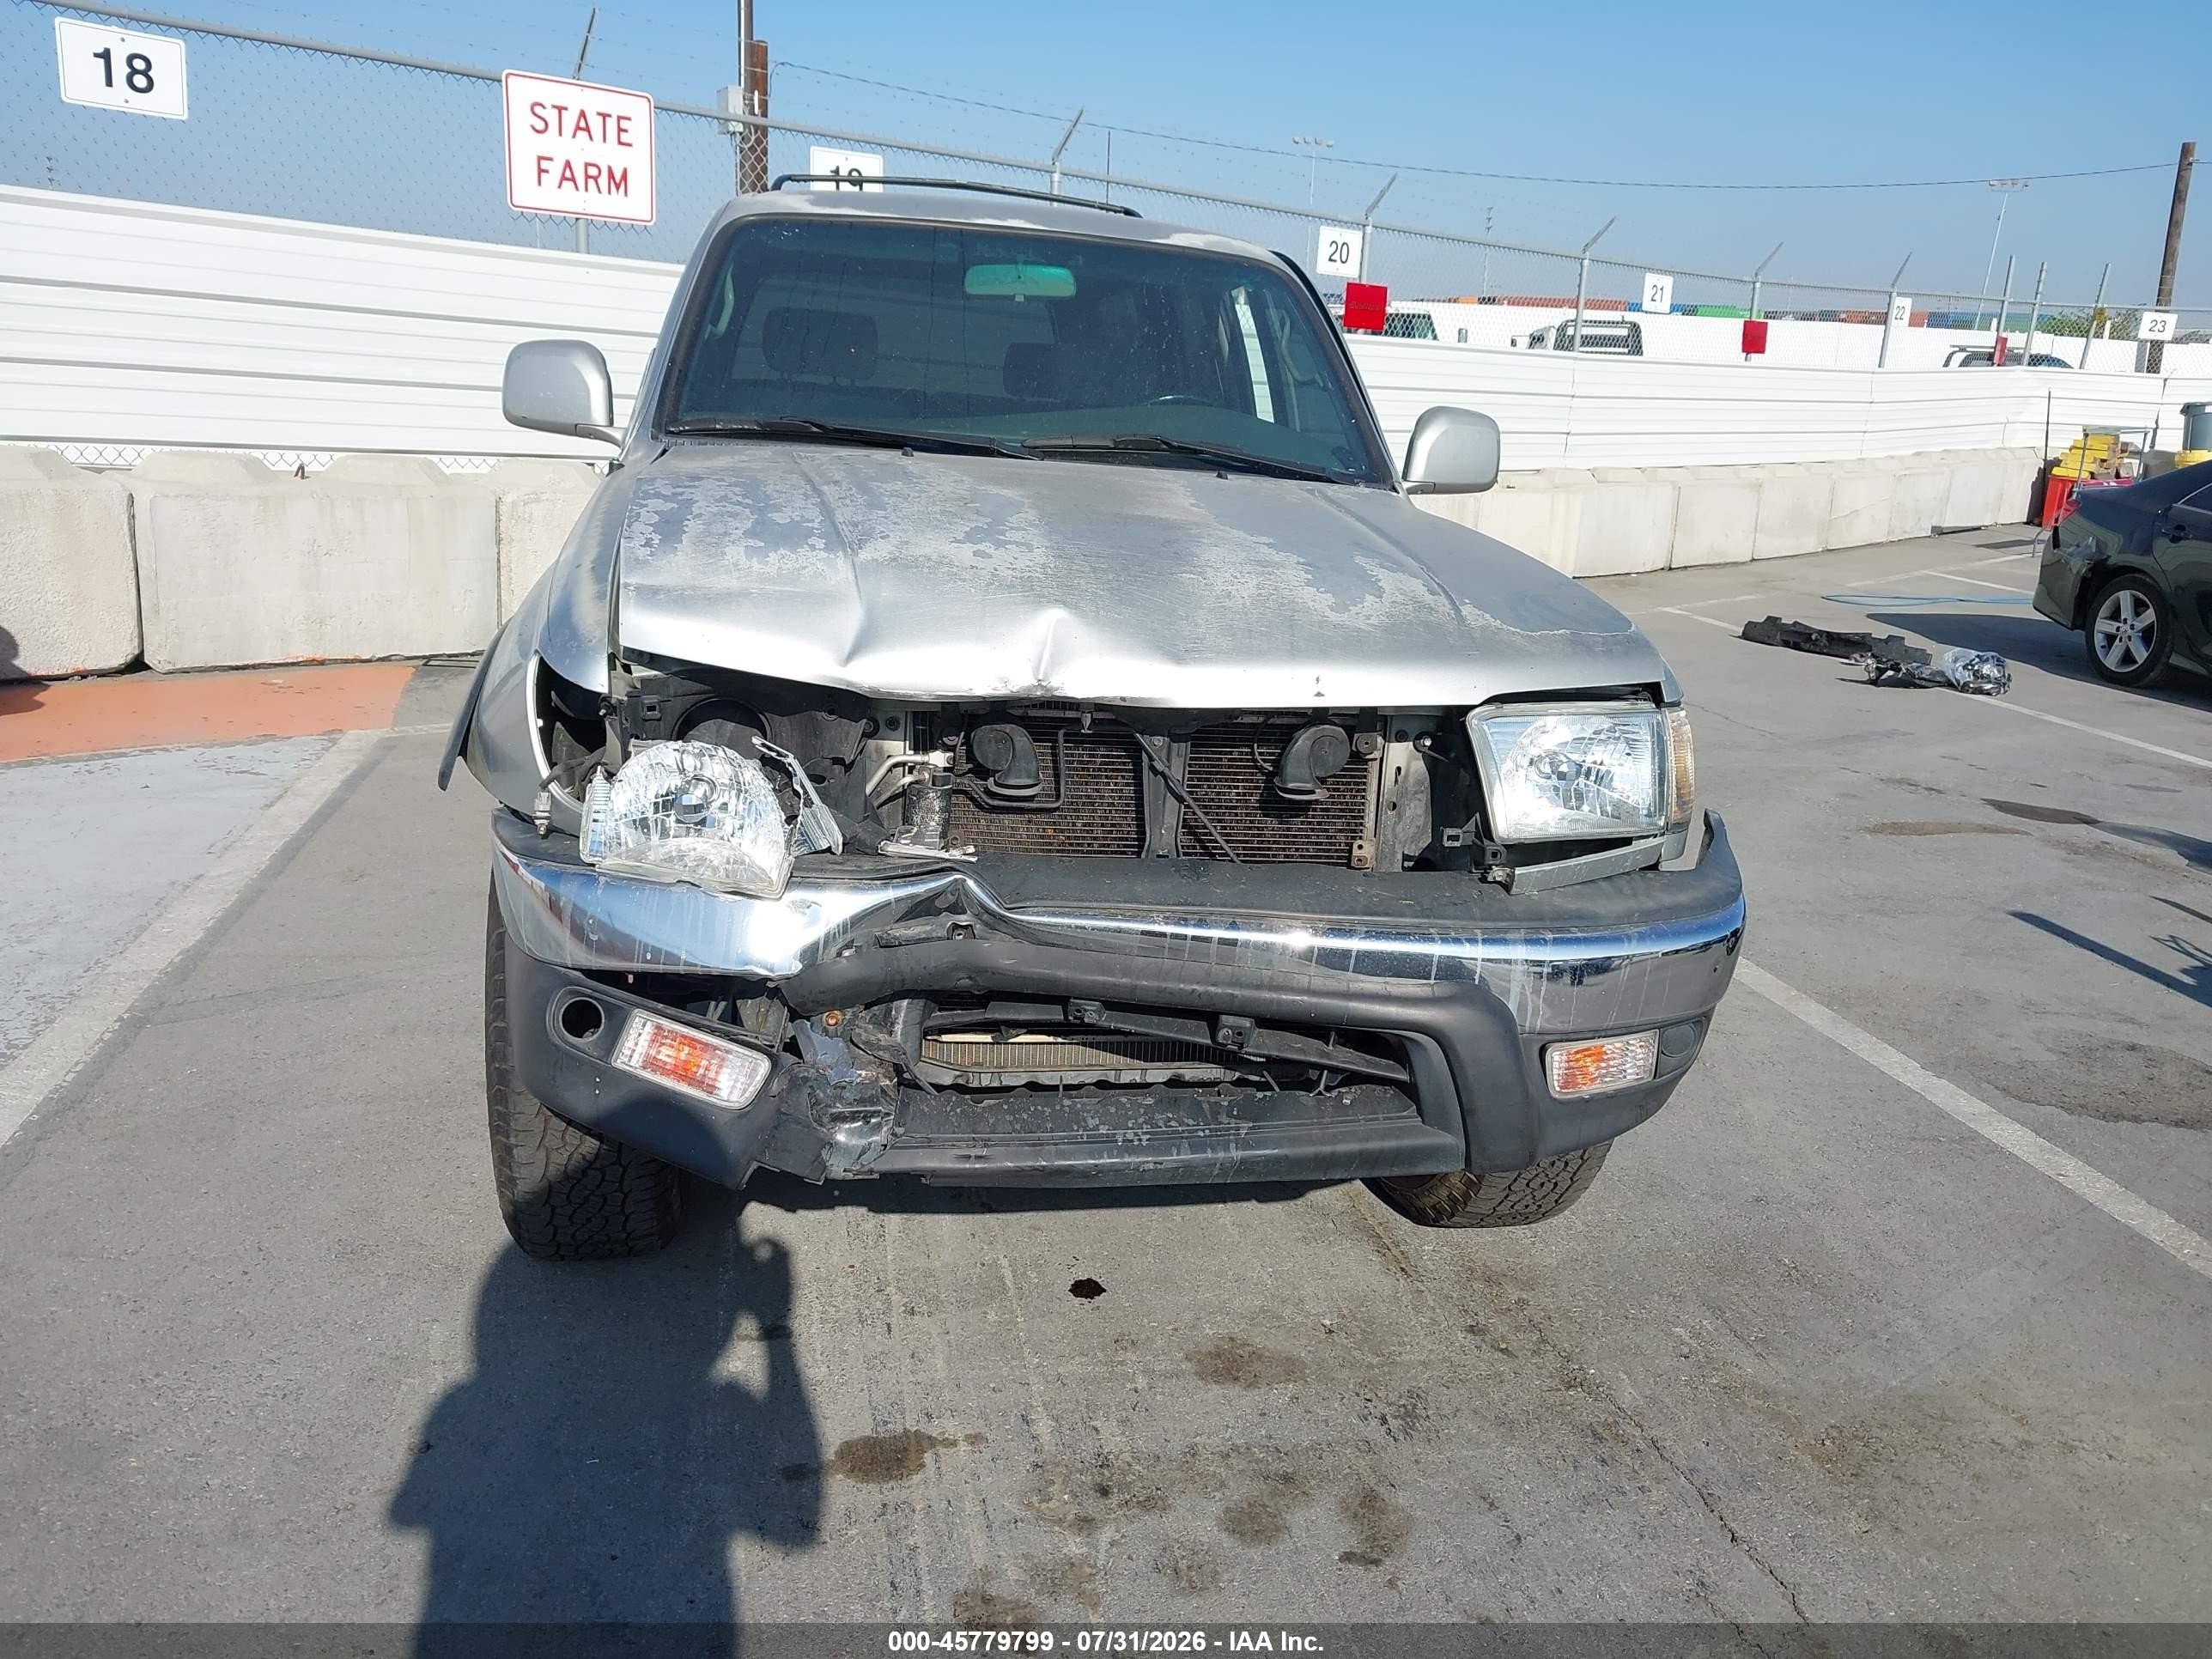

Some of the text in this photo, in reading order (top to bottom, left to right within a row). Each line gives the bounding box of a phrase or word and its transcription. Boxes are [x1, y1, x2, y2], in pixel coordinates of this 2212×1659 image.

[93, 47, 155, 94] 18
[530, 101, 634, 147] STATE
[537, 156, 629, 198] FARM
[830, 165, 863, 191] 19
[1328, 240, 1350, 264] 20
[1651, 284, 1665, 303] 21
[1894, 306, 1905, 320] 22
[2148, 319, 2167, 333] 23
